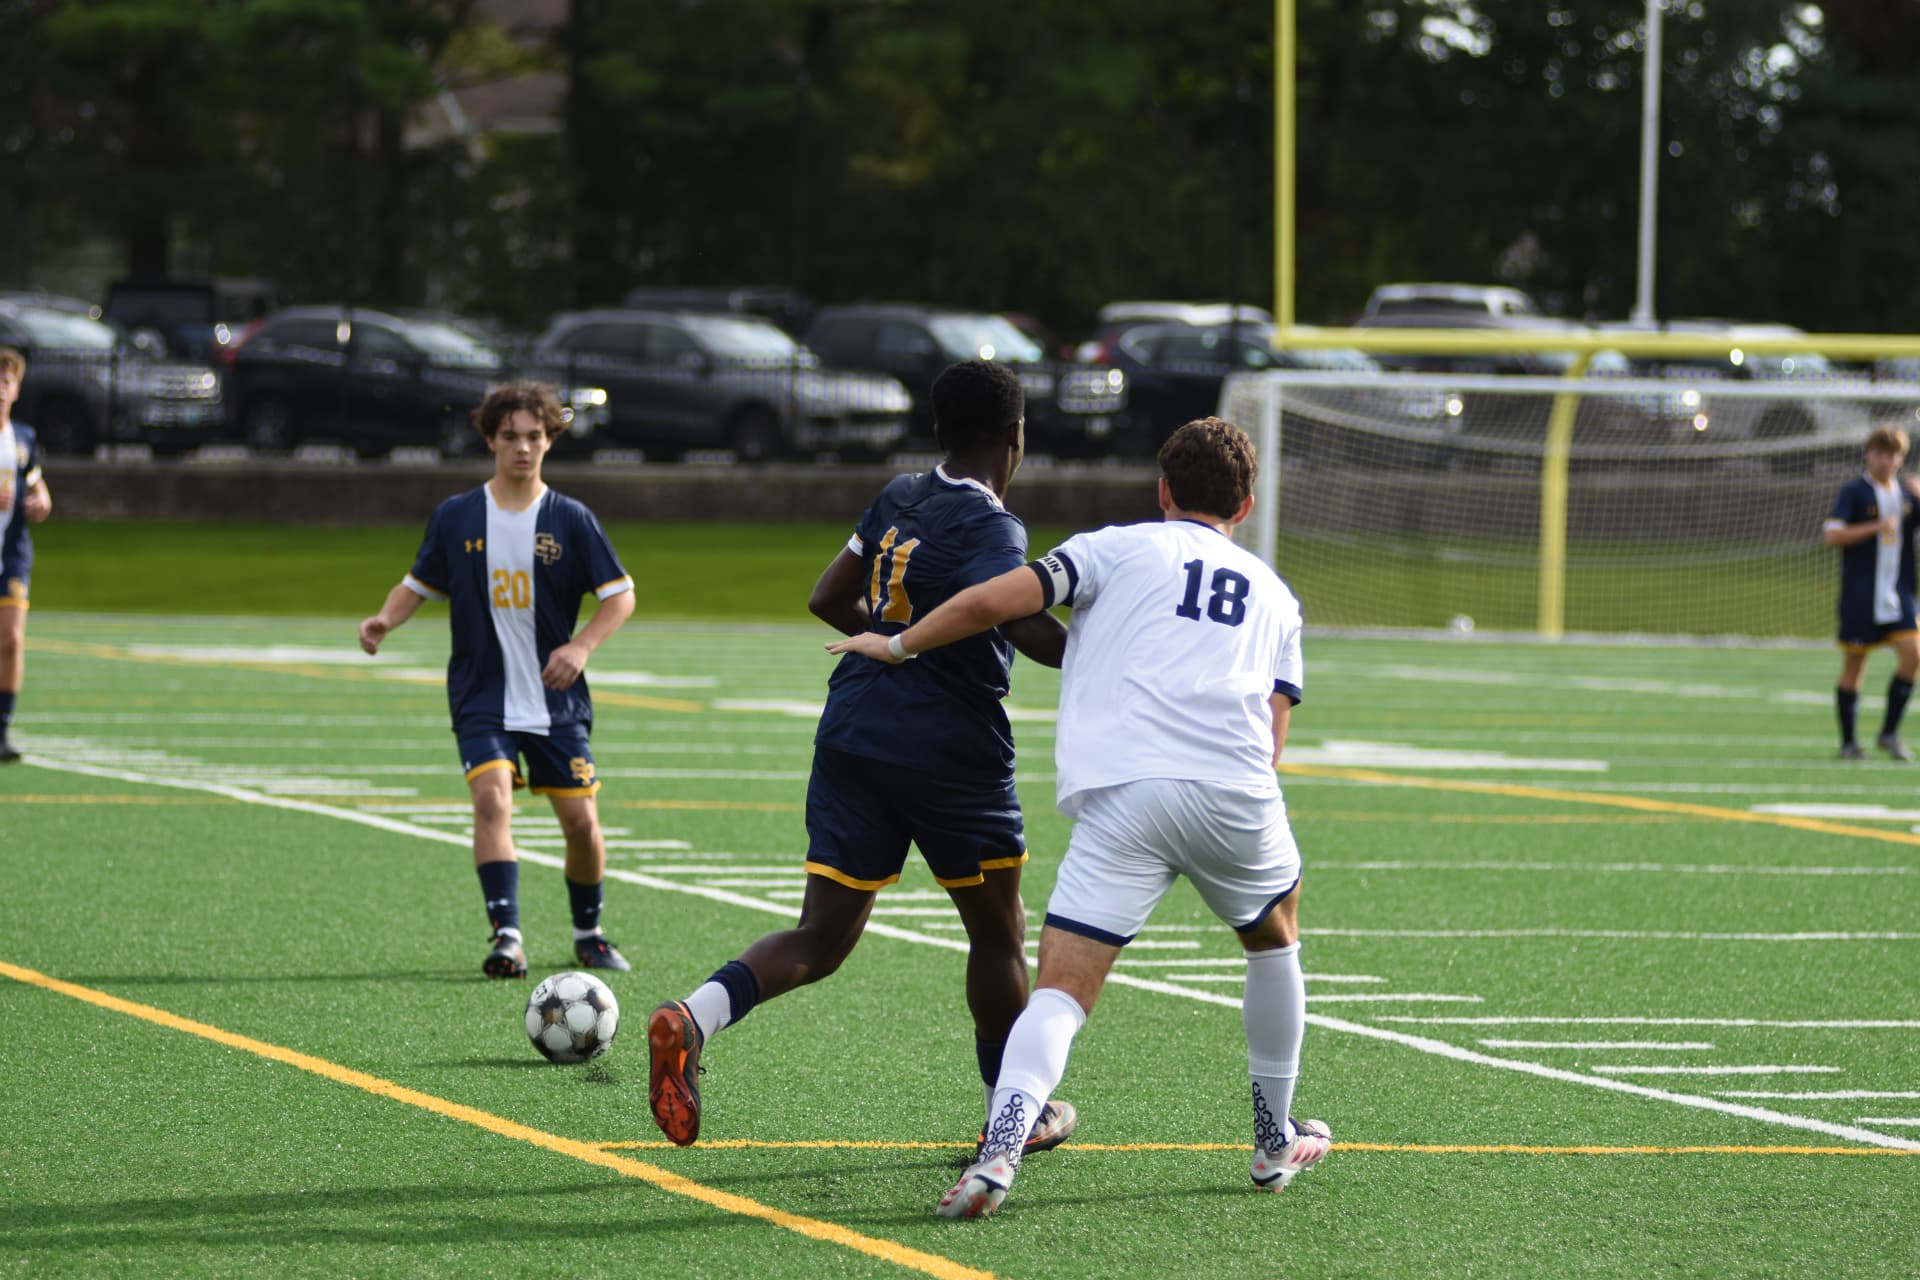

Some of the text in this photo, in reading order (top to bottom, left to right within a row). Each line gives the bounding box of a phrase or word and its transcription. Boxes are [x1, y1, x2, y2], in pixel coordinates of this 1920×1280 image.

[492, 570, 531, 608] 20
[870, 526, 920, 625] 11
[1176, 559, 1250, 627] 18
